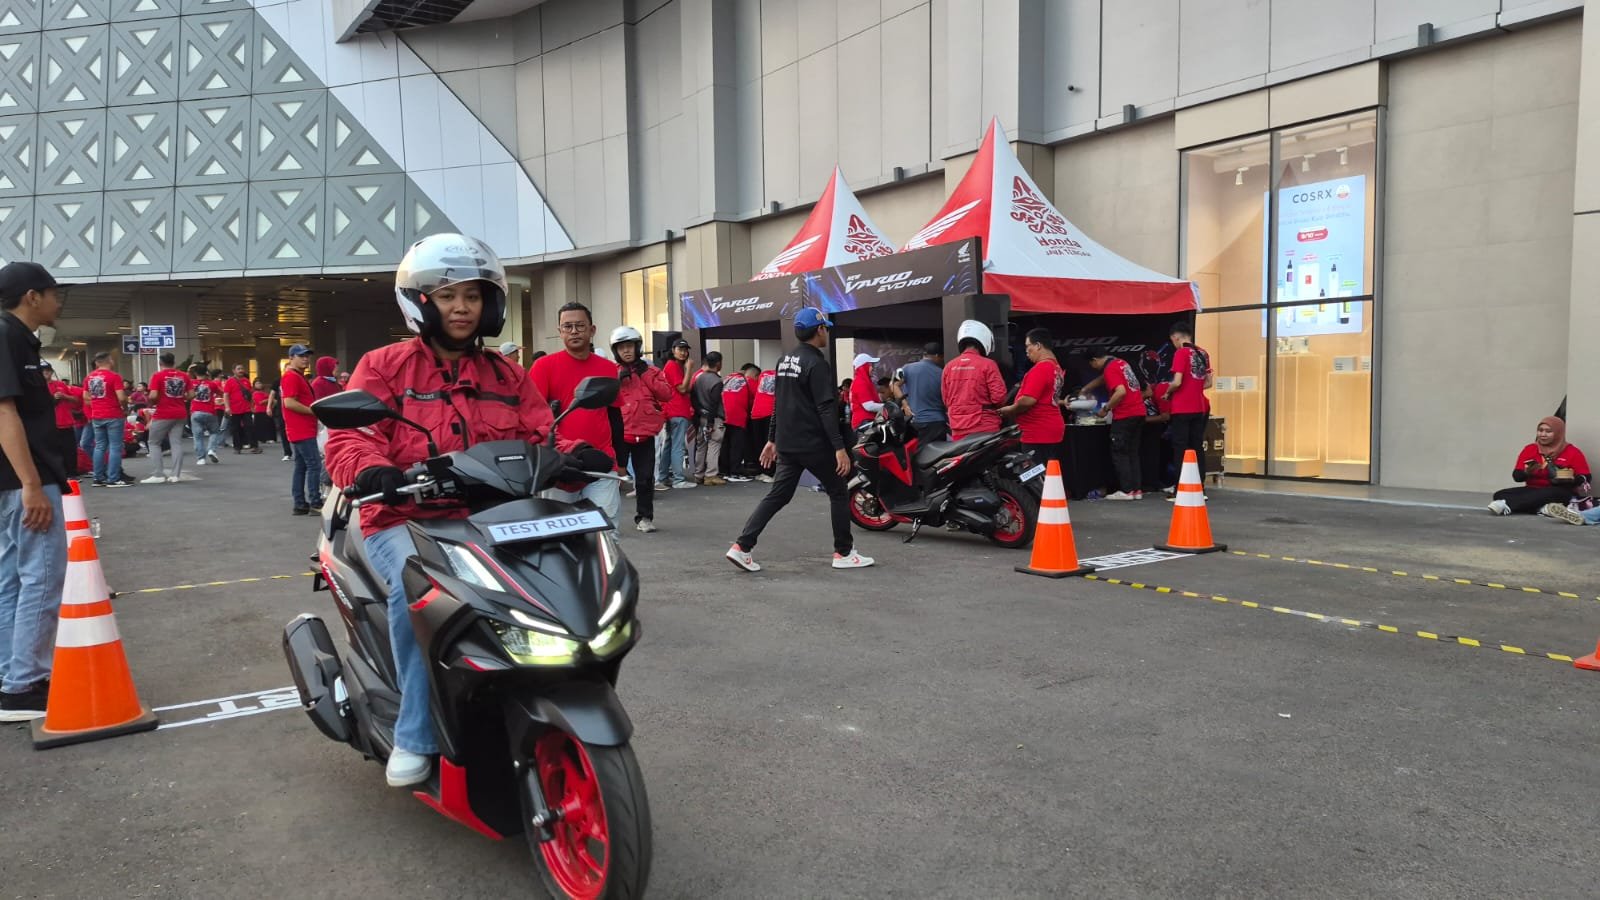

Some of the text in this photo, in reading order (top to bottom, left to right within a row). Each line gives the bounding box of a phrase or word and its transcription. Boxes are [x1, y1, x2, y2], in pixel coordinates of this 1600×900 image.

[1292, 188, 1333, 204] COSRX
[1035, 236, 1082, 248] Honda
[845, 270, 913, 294] VARIO
[876, 275, 934, 293] EVO 160
[711, 296, 760, 313] VARIO
[1110, 344, 1147, 353] 160
[496, 515, 591, 536] TEST RIDE
